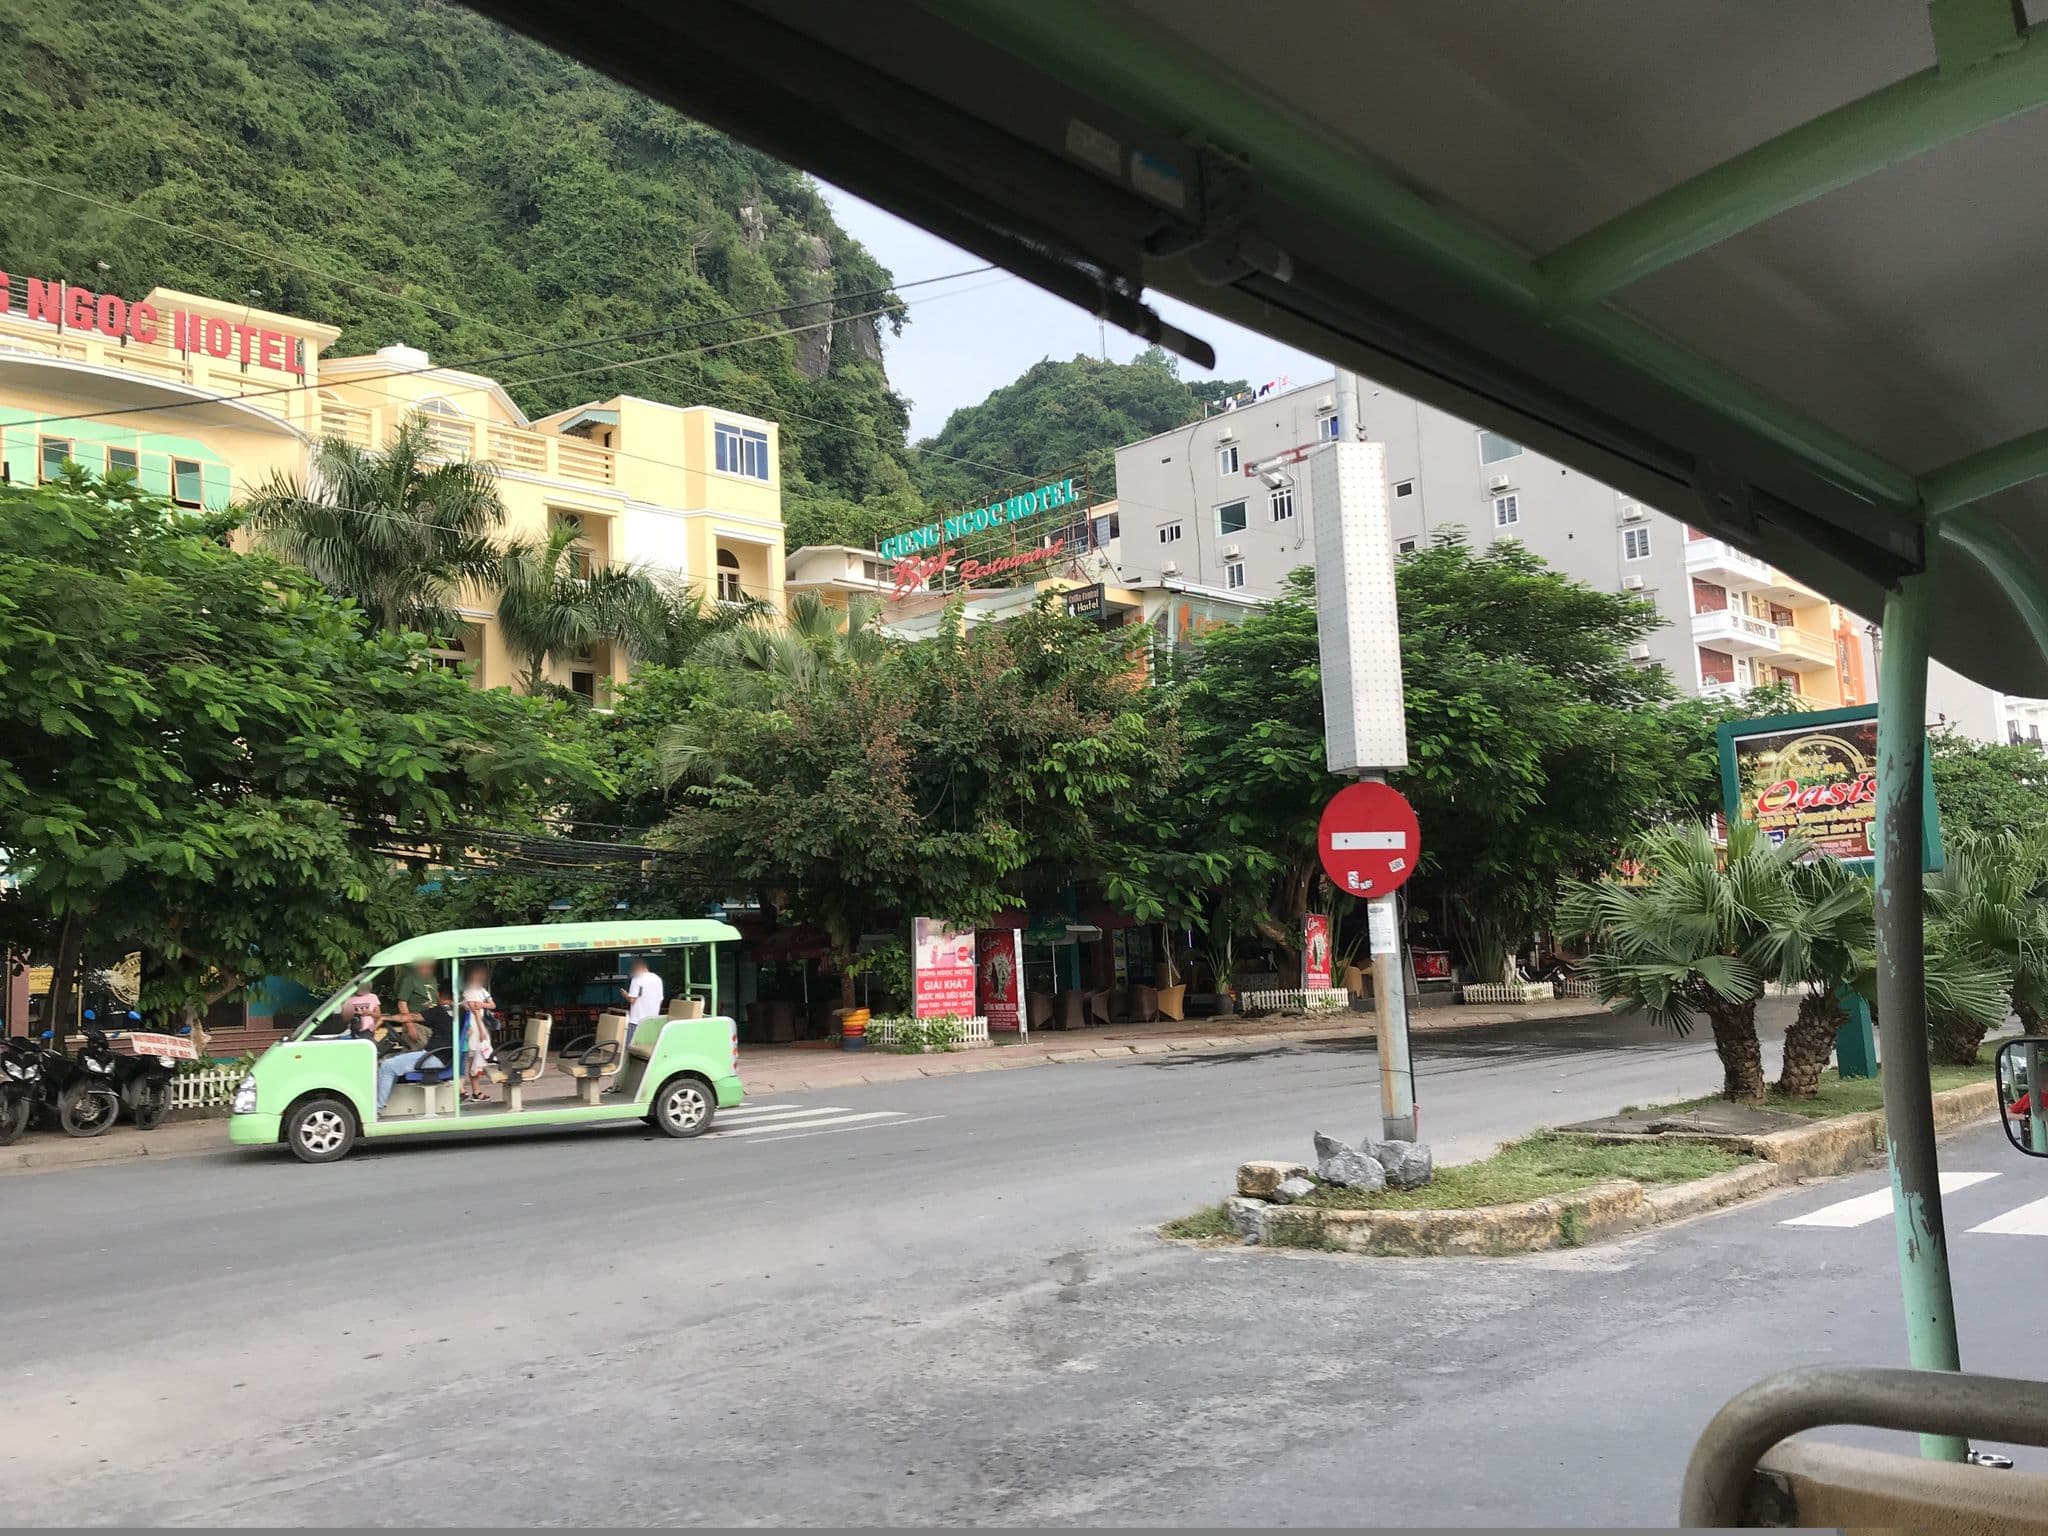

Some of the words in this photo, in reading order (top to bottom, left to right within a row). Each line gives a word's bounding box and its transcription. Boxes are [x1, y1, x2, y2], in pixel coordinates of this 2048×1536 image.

[174, 310, 305, 374] HOTEL
[1005, 479, 1079, 523] HOTEL
[960, 537, 1065, 582] Restaurant
[1077, 598, 1099, 613] Hostel
[1757, 774, 1877, 812] Oasis
